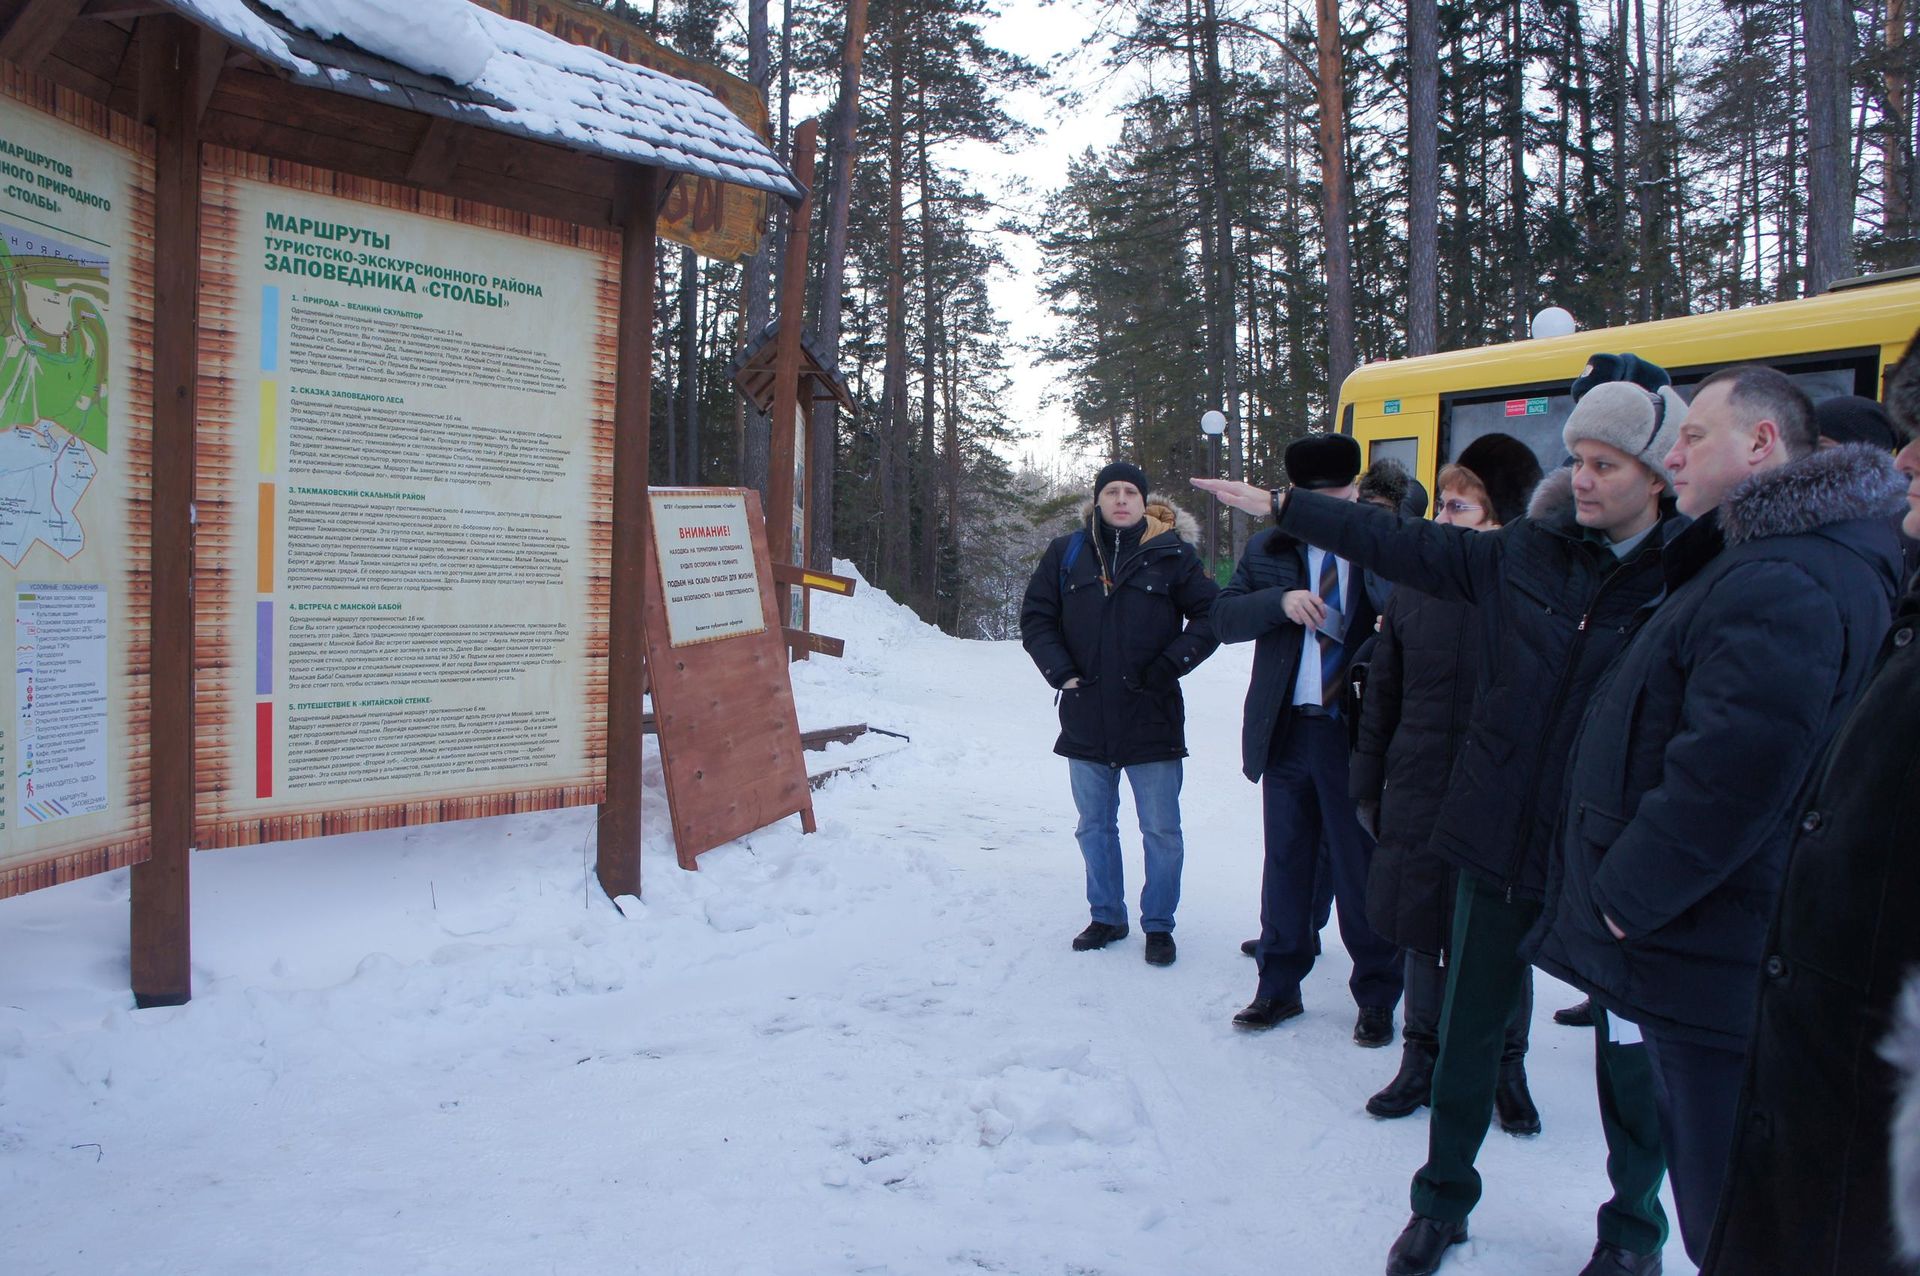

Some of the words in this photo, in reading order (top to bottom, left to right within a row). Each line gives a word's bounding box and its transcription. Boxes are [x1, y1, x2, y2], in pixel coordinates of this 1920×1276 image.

[0, 140, 72, 178] МАРШРУТОВ
[0, 161, 34, 183] НОГО
[37, 175, 111, 212] ПРИРОДНОГО
[4, 184, 61, 212] «СТОЛБЫ»
[266, 211, 390, 251] МАРШРУТЫ
[264, 236, 486, 287] ТУРИСТСКО-ЭКСКУРСИОННОГО
[492, 275, 543, 297] РАЙОНА
[264, 252, 416, 294] ЗАПОВЕДНИКА
[422, 279, 510, 310] «СТОЛБЫ»
[303, 296, 339, 308] ПРИРОДА
[348, 302, 382, 314] ВЕЛИКИЙ
[384, 308, 423, 320] СКУЛЬПТОР
[300, 387, 330, 397] СКАЗКА
[332, 390, 385, 403] ЗАПОВЕДНОГО
[386, 396, 404, 404] ЛЕСА
[298, 486, 358, 497] ТАКМАКОВСКИЙ
[360, 490, 400, 500] СКАЛЬНЫЙ
[402, 493, 426, 501] РАЙОН
[679, 526, 731, 539] ВНИМАНИЕ!
[684, 592, 711, 601] БЕЗОПАСНОСТЬ
[298, 701, 351, 710] ПУТЕШЕСТВИЕ
